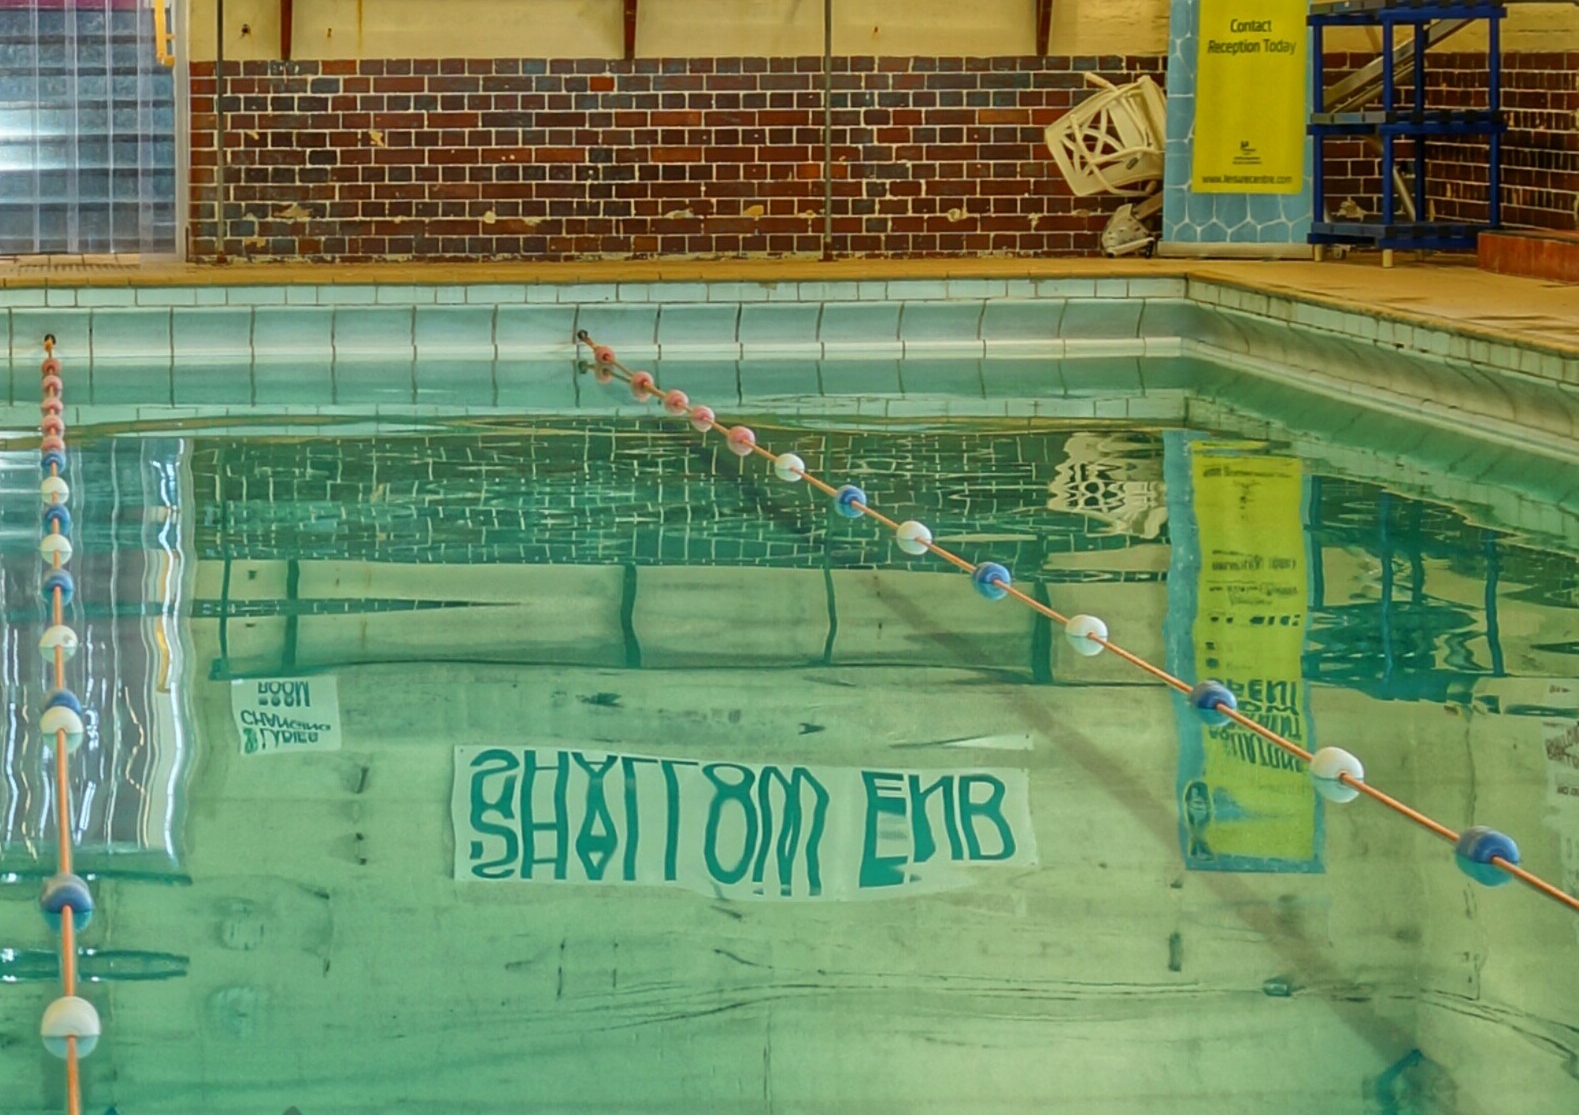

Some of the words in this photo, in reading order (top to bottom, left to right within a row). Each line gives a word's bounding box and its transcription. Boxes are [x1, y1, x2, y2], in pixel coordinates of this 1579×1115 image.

[1230, 19, 1272, 33] Contact
[1208, 40, 1260, 56] Reception
[1263, 39, 1296, 55] Today
